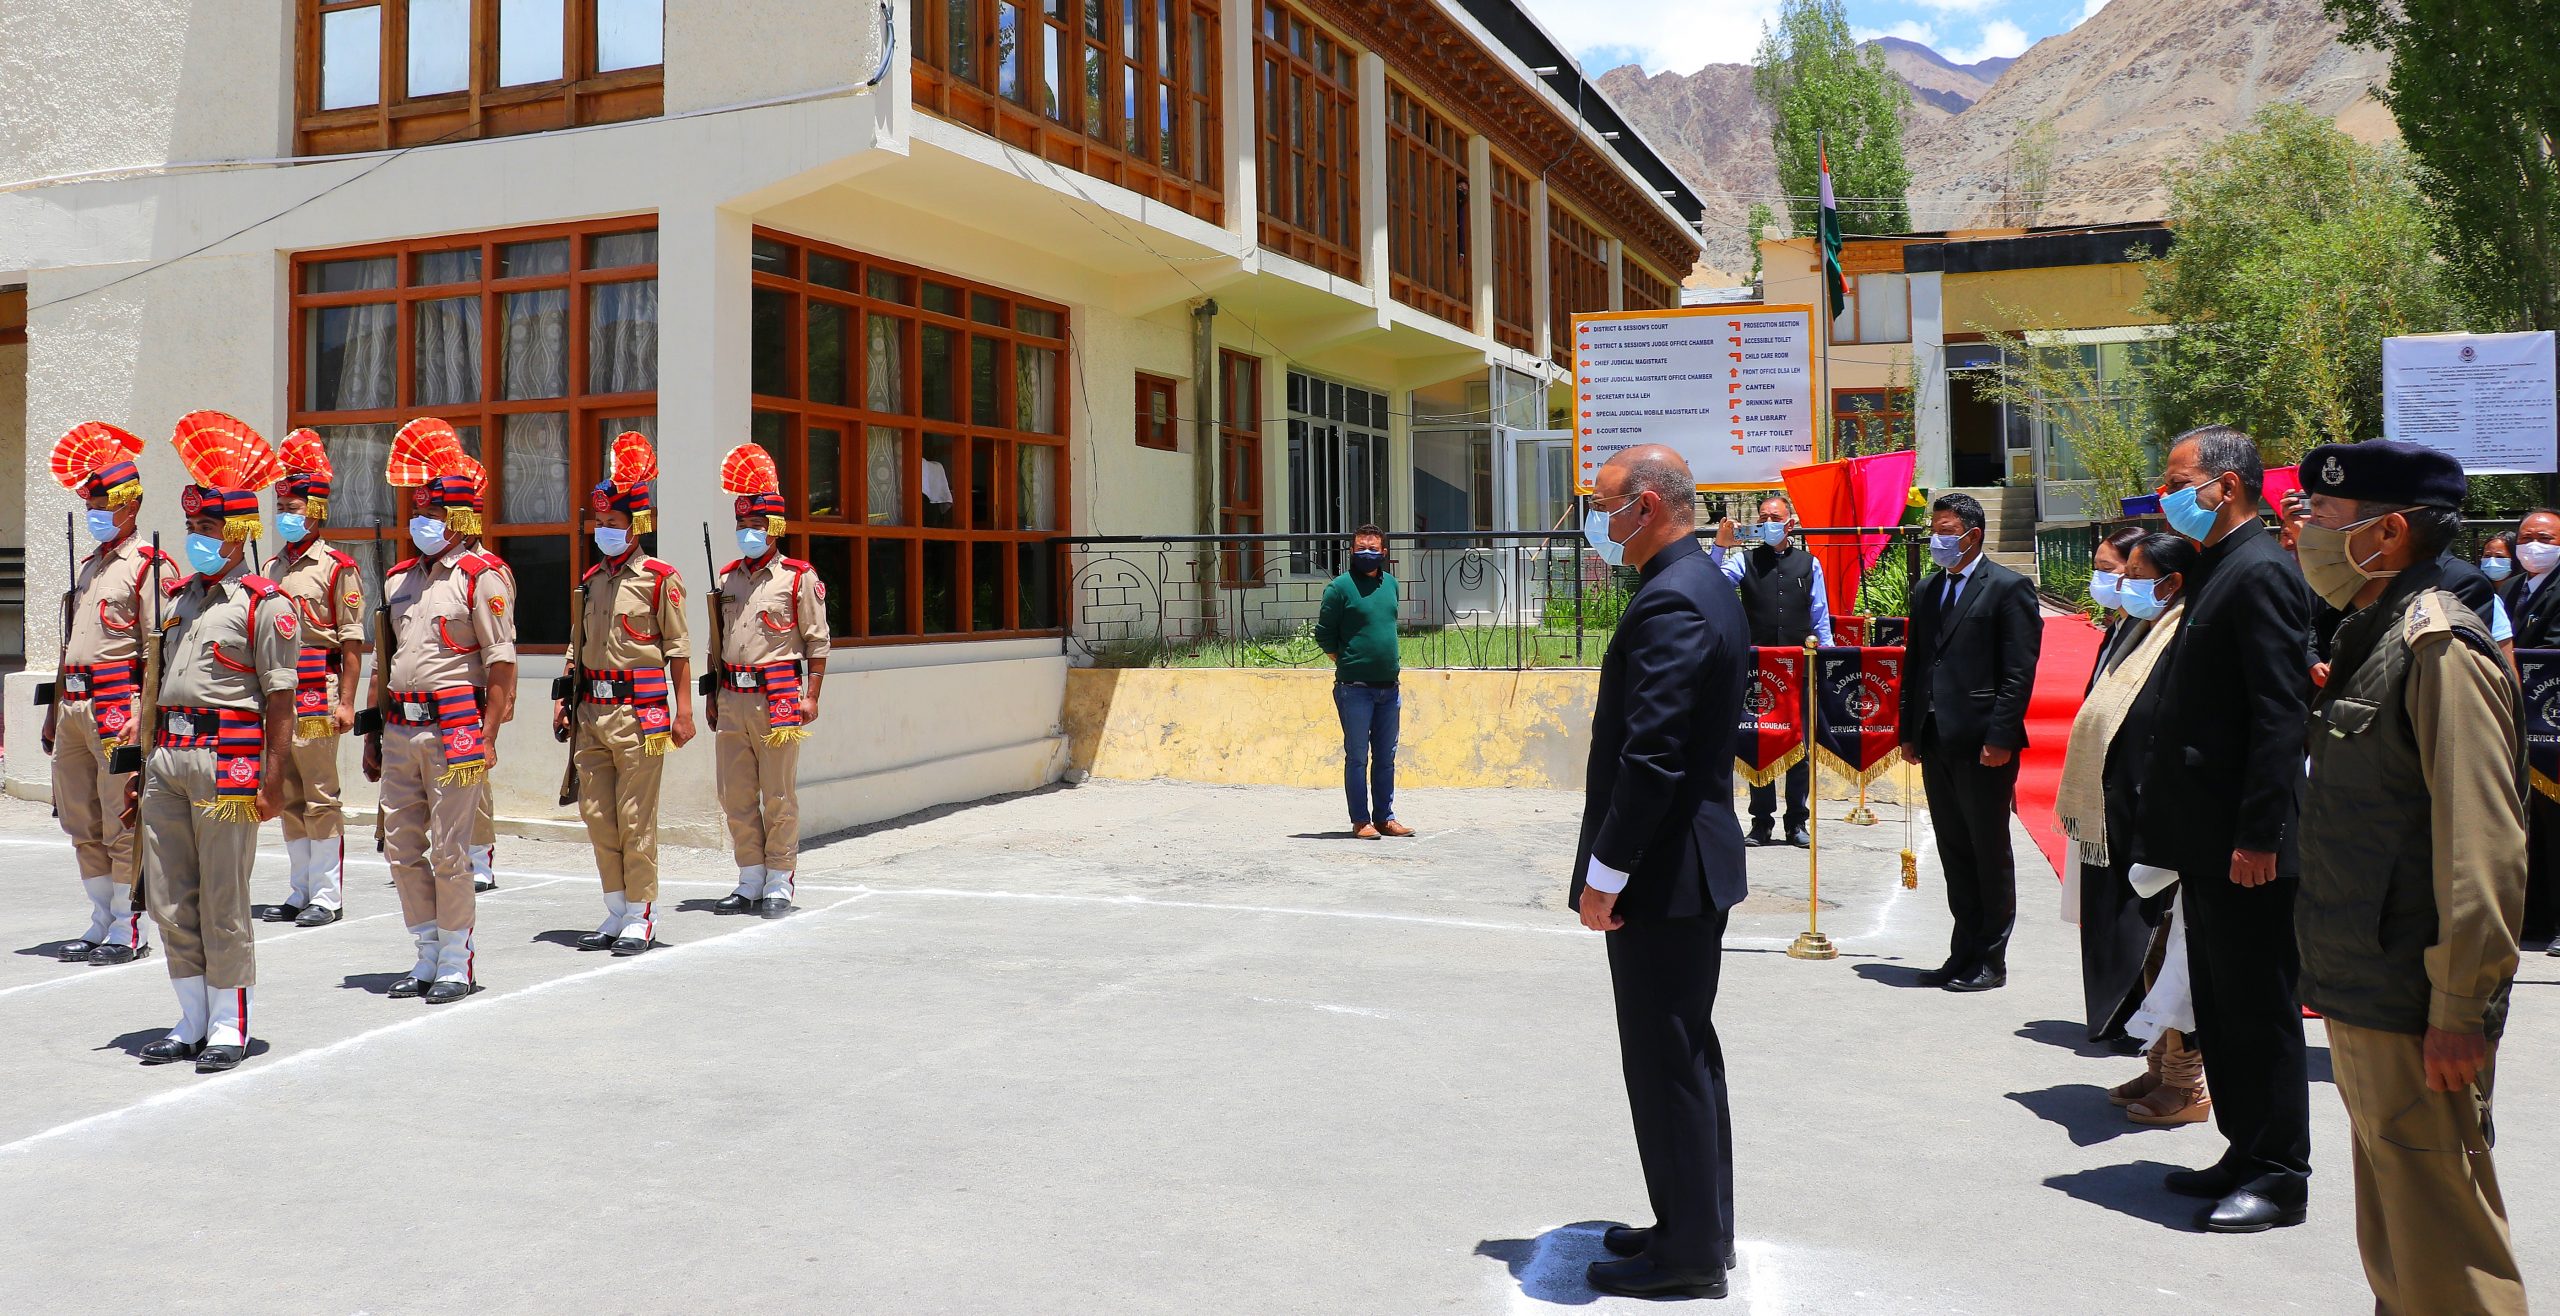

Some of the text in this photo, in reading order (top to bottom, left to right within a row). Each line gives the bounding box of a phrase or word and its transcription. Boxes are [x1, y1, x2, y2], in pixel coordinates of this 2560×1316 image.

[1761, 670, 1788, 692] POLICE
[1832, 672, 1892, 694] LADAKH POLICE
[1760, 722, 1790, 730] COURAGE
